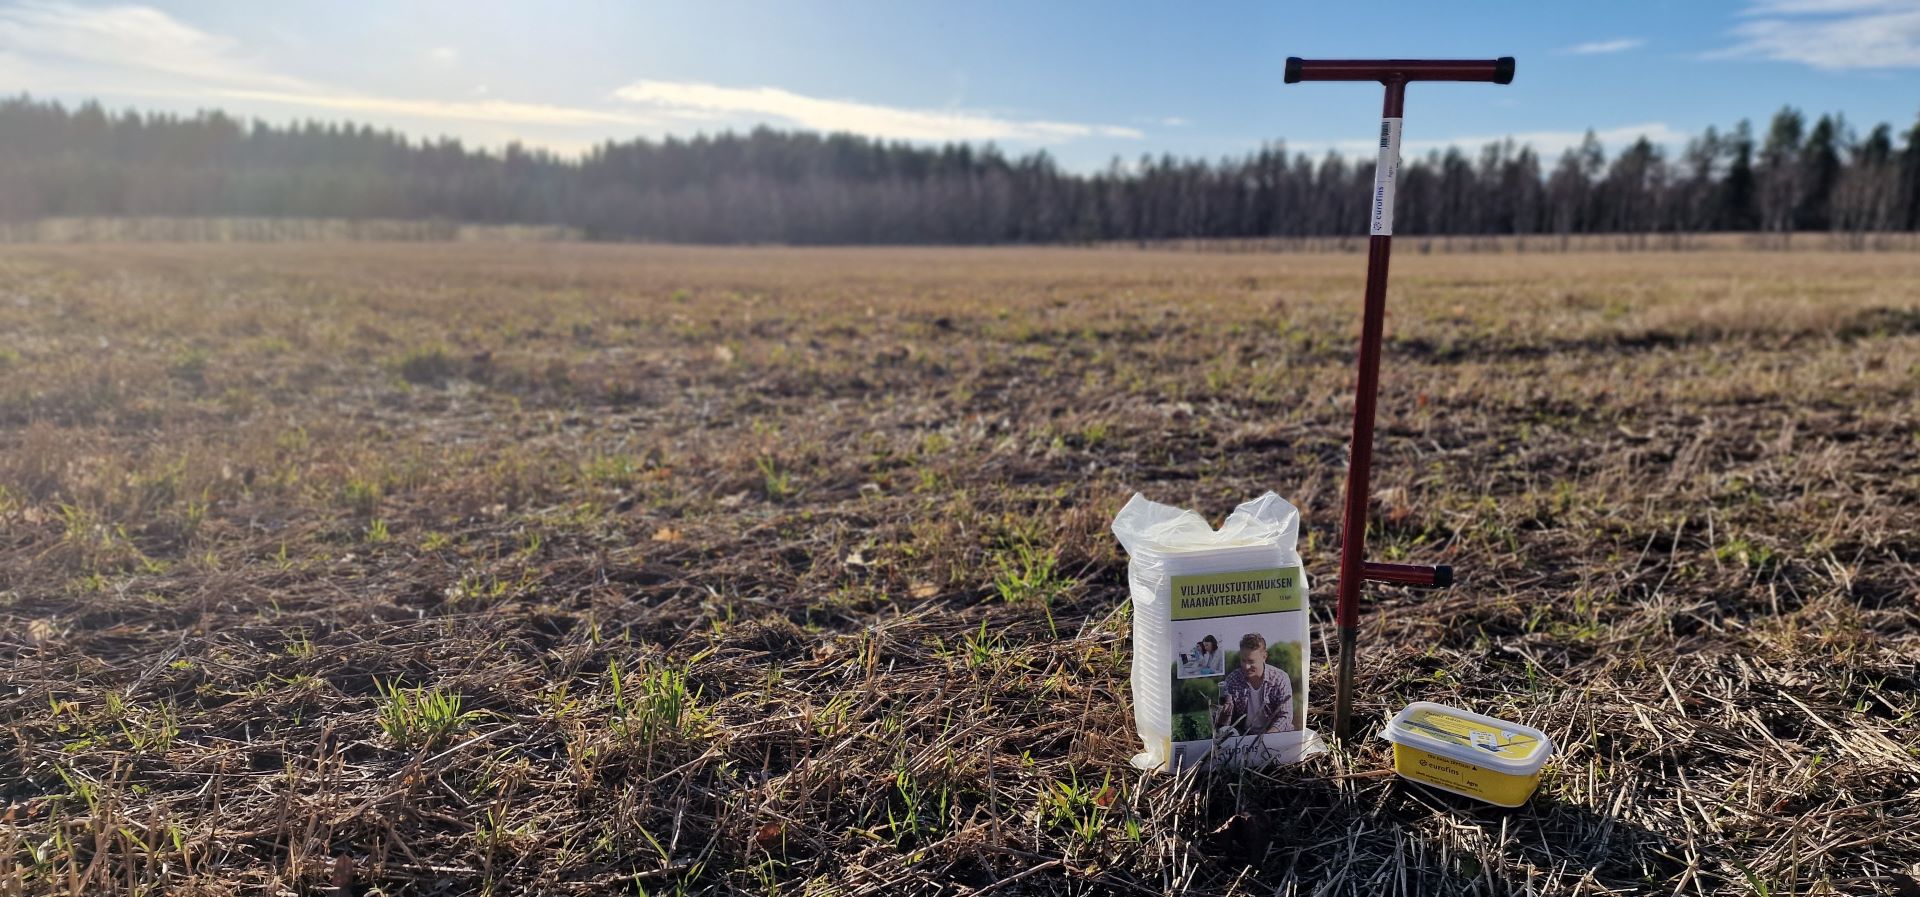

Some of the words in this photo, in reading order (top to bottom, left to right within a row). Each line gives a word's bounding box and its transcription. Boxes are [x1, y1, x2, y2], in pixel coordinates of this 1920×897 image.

[1376, 186, 1384, 220] eurofins
[1181, 577, 1293, 596] VILJAVUUSTUTKIMUKSEN
[1181, 593, 1262, 609] MAANÄYTERASIAT
[1428, 763, 1460, 776] eurofins
